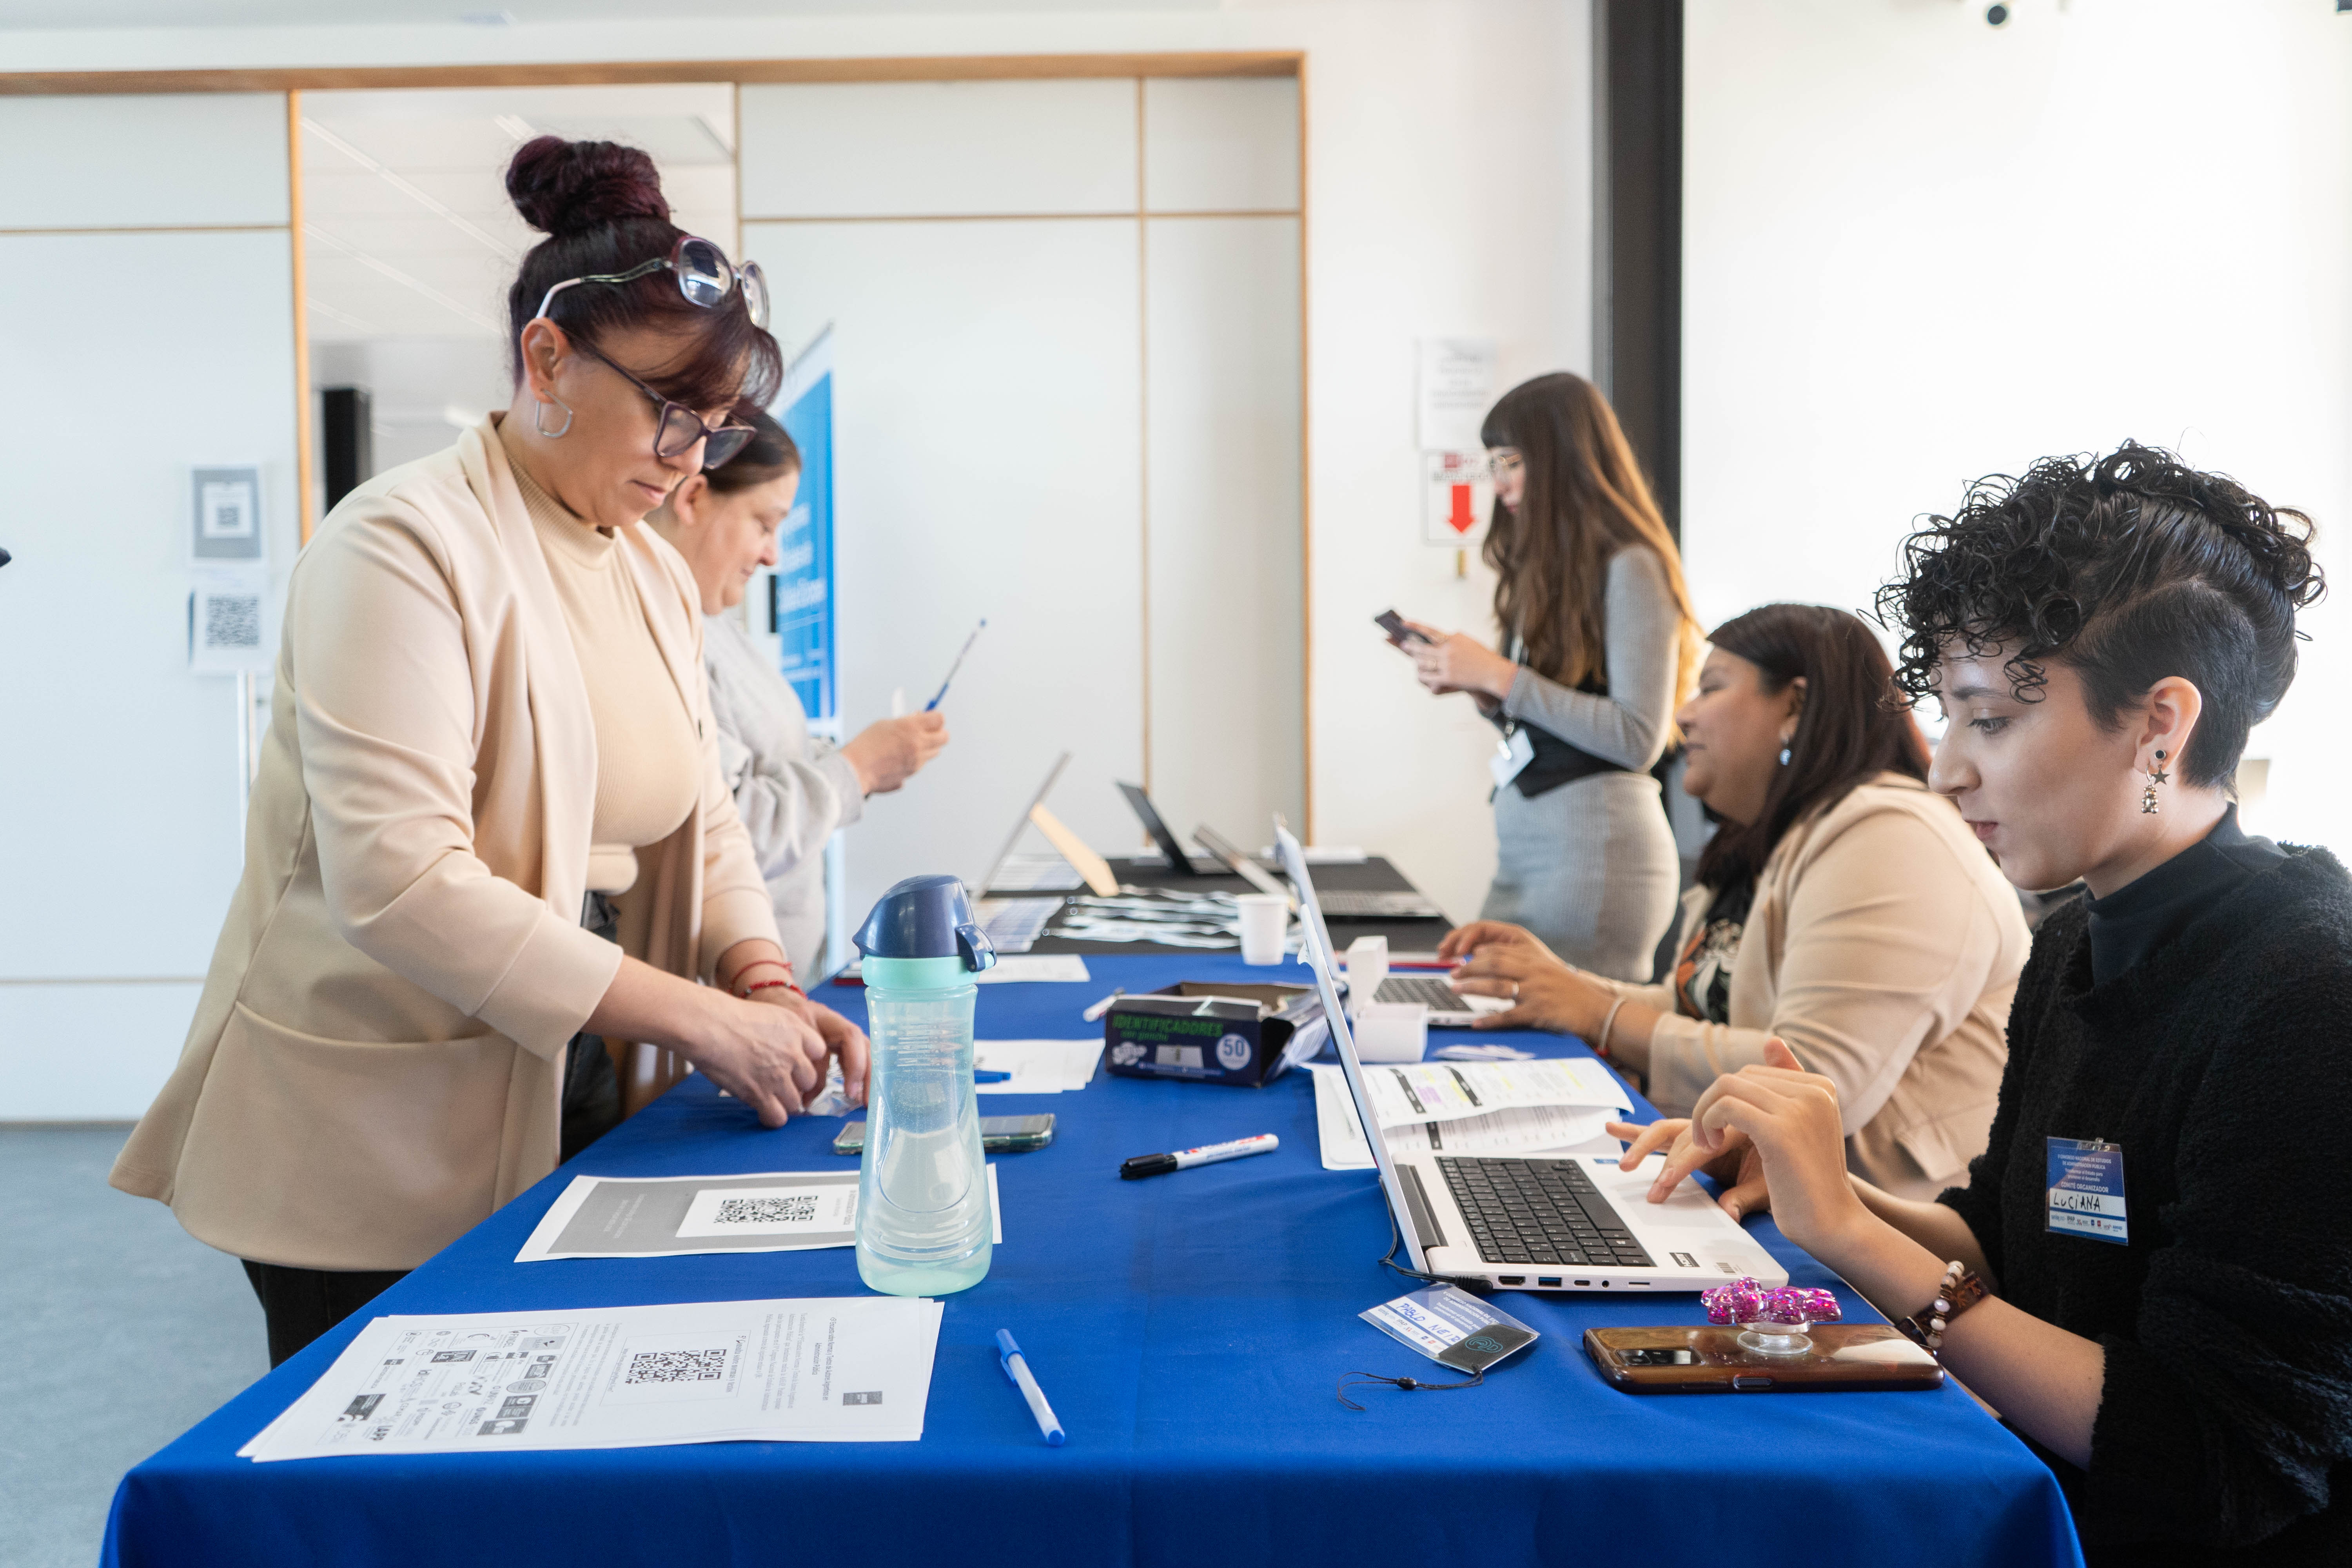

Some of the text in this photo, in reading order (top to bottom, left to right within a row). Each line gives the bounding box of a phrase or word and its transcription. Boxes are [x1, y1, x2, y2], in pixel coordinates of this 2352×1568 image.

[1112, 1014, 1223, 1037] IDENTIFICADORES
[1223, 1041, 1245, 1058] 50
[2061, 1180, 2109, 1193] COMITÉ ORGANIZADOR
[1396, 1303, 1426, 1322] PABLO
[1466, 1303, 1484, 1315] NACIONAL
[1460, 1316, 1473, 1325] Estado
[503, 1334, 519, 1348] FINDEL
[735, 1339, 745, 1354] Consulta
[732, 1354, 742, 1364] sobre
[813, 1342, 822, 1364] Administración
[728, 1365, 738, 1379] normas
[725, 1382, 735, 1393] textos
[822, 1381, 831, 1396] Argentinos
[482, 1390, 500, 1405] UNPAZ
[469, 1412, 485, 1424] UNGS
[369, 1425, 392, 1440] IAPP
